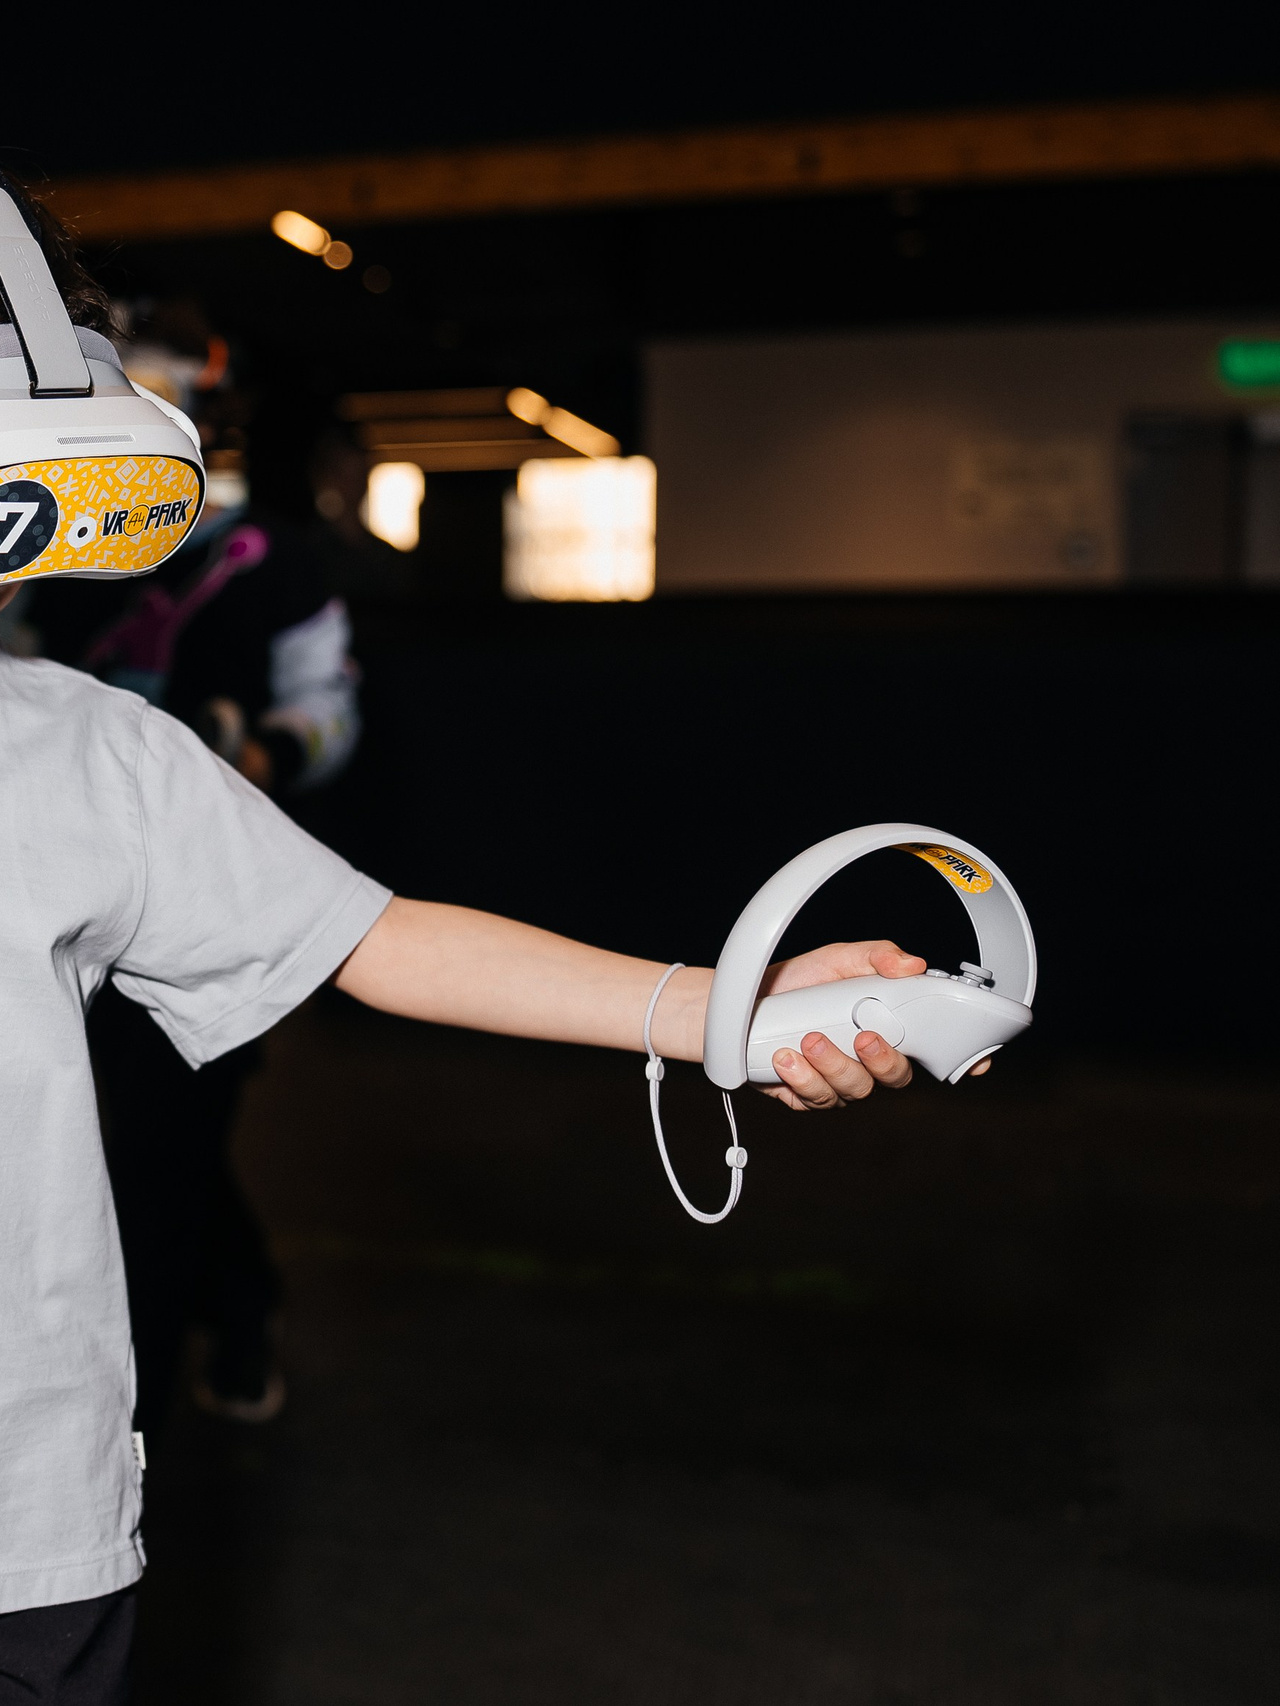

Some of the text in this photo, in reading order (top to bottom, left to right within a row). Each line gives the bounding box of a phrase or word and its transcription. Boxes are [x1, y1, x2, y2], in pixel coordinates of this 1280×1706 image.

[102, 510, 128, 536] VR
[144, 498, 193, 530] PARK
[939, 854, 981, 883] PARK
